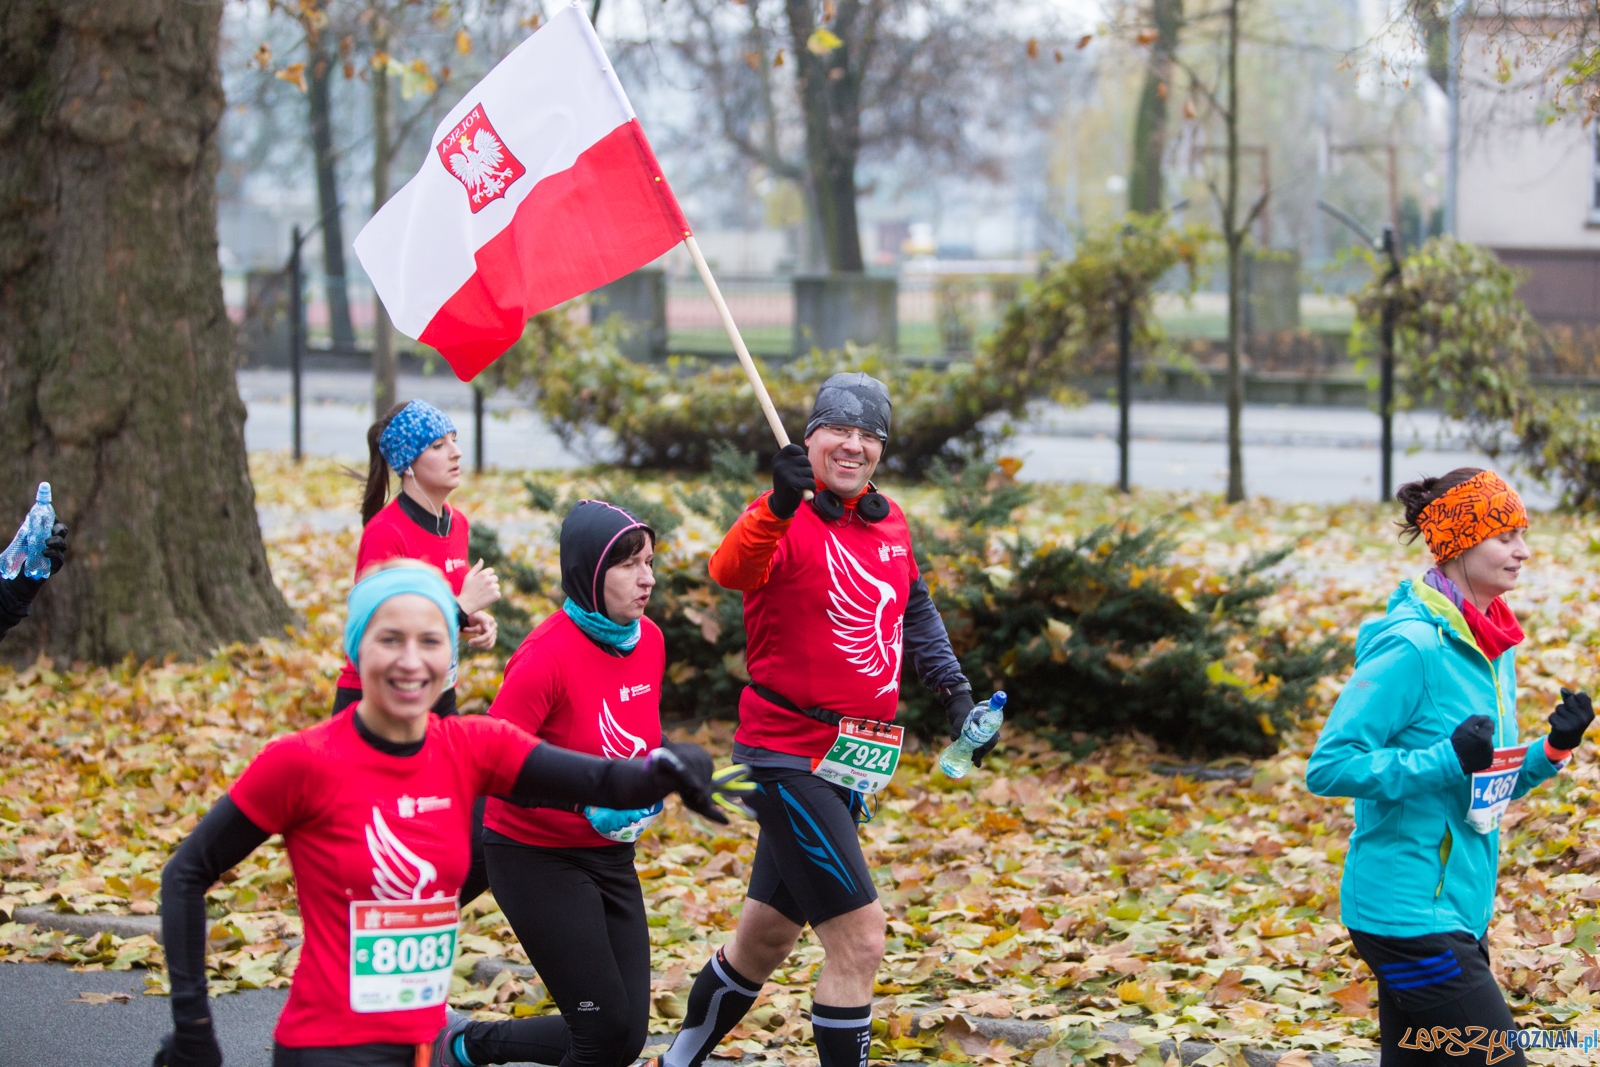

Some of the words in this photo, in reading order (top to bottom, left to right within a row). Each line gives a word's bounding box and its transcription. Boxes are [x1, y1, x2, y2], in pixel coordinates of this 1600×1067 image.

[839, 741, 893, 772] 7924
[1475, 788, 1481, 798] E
[1482, 772, 1520, 804] 4361
[372, 933, 452, 974] 8083
